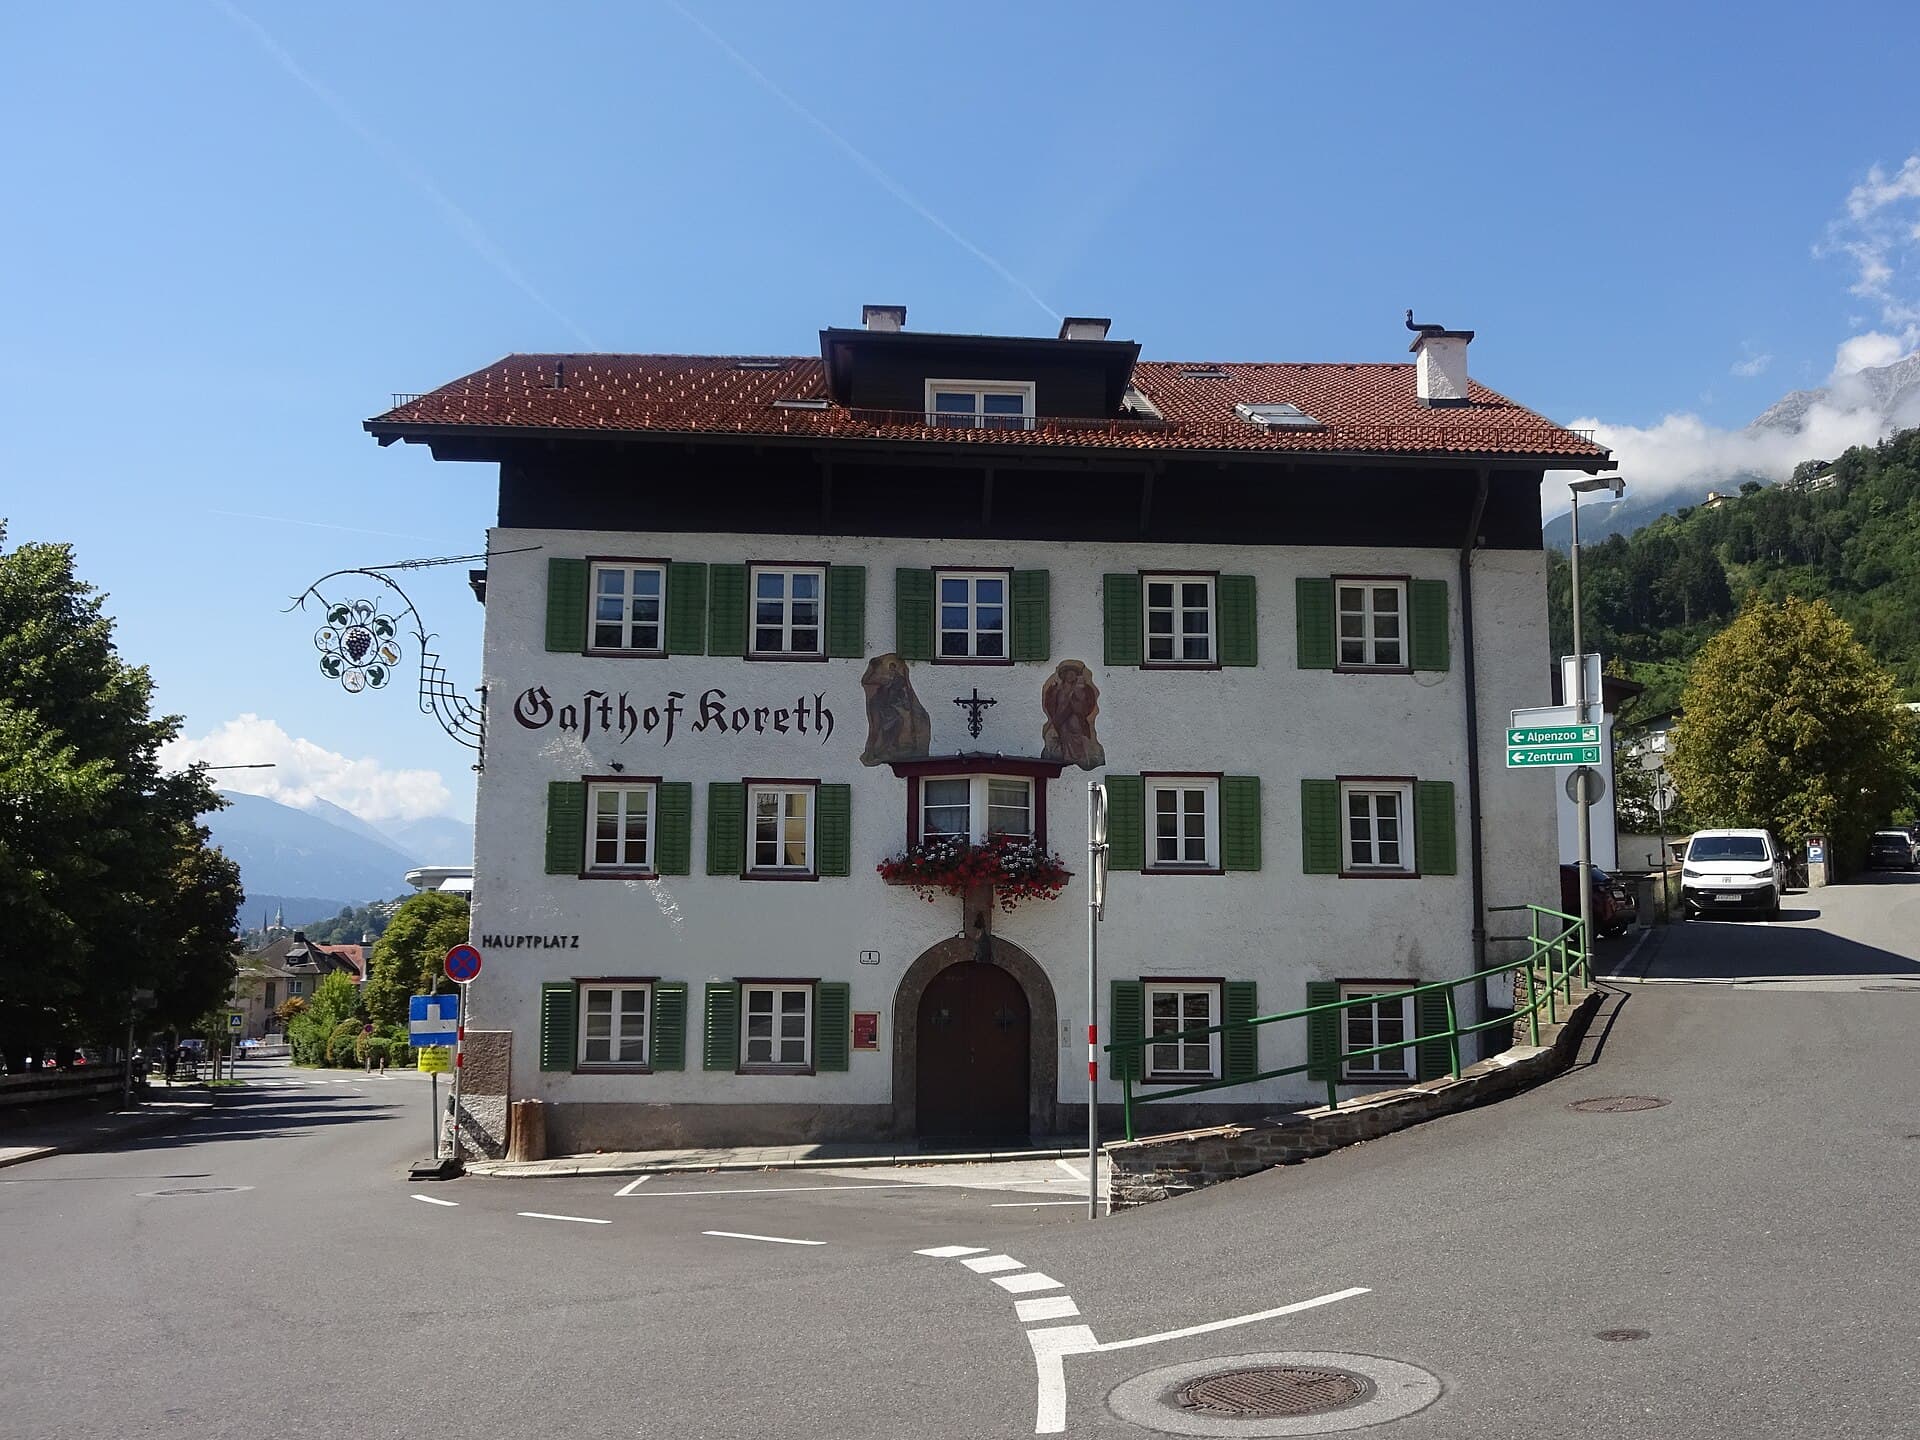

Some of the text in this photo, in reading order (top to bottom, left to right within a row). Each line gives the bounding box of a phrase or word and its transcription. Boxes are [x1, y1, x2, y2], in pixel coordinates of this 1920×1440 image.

[691, 688, 835, 746] Koreth
[1527, 731, 1577, 743] Alpenzoo
[1527, 752, 1574, 762] Zentrum
[482, 934, 580, 949] HAUPTPLATZ
